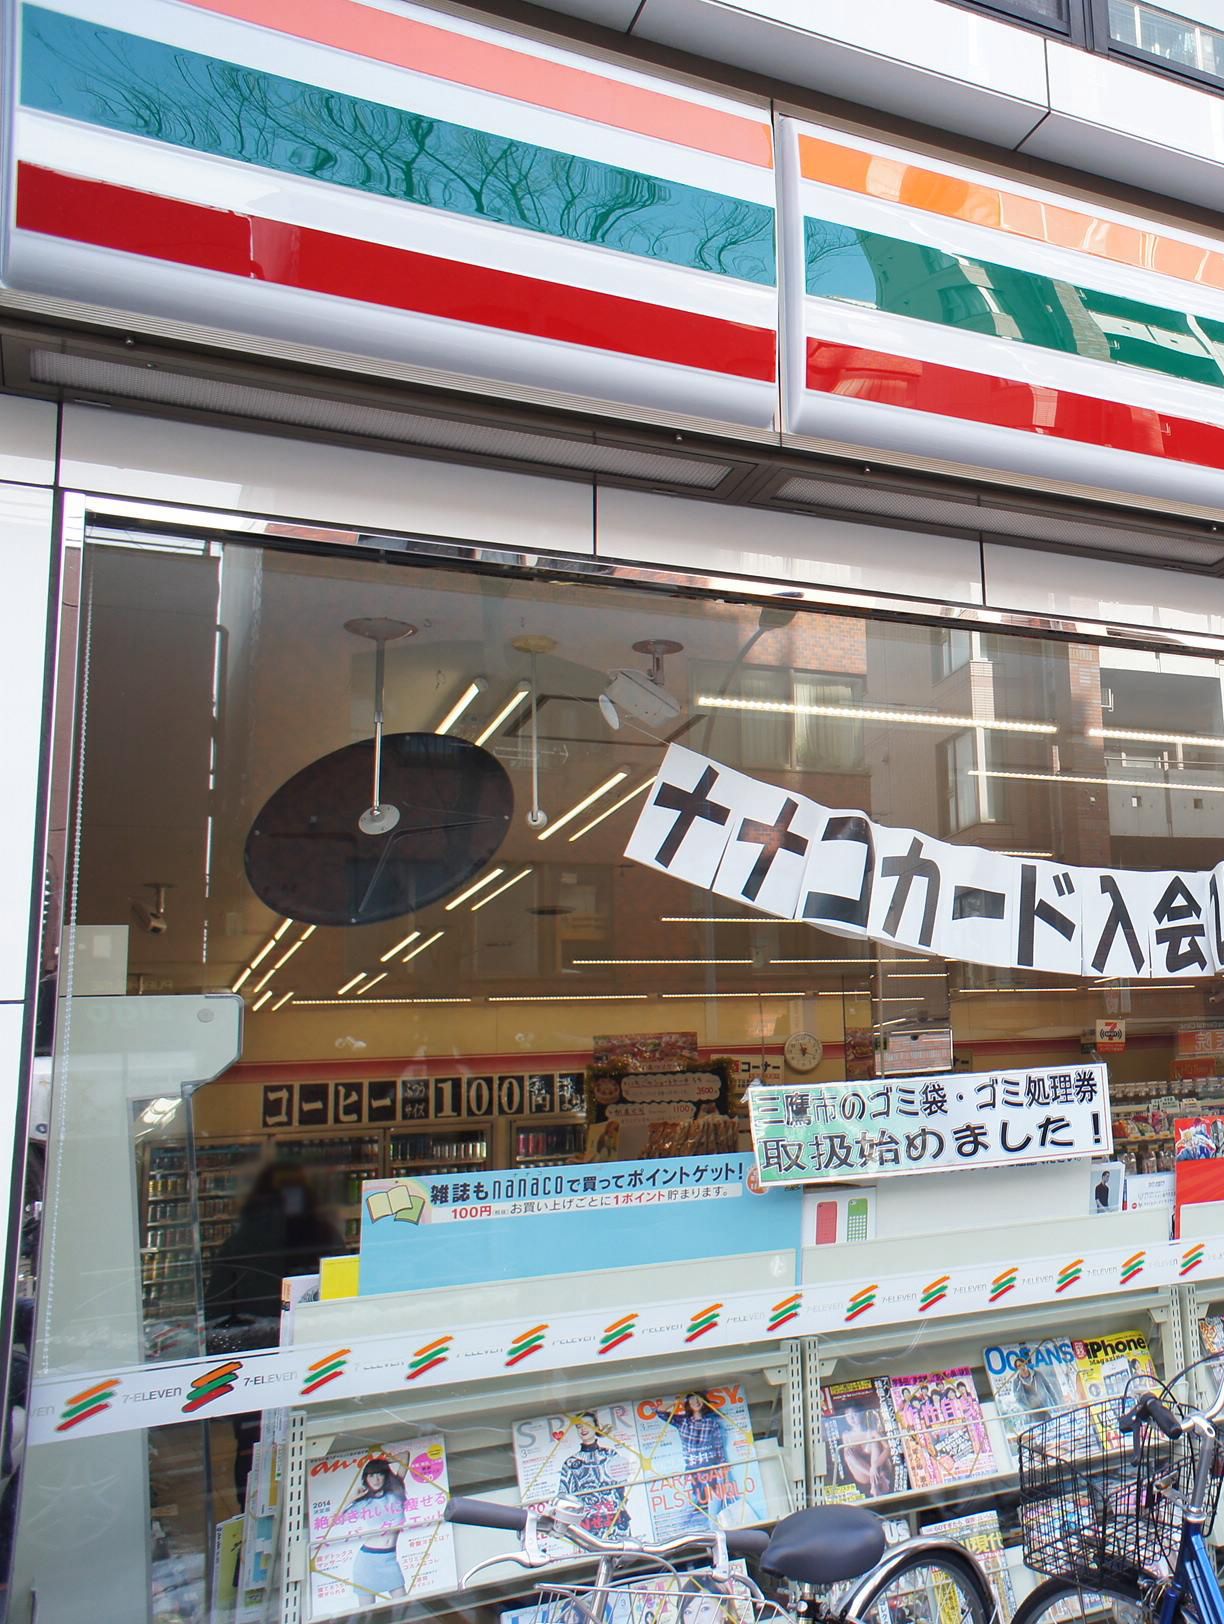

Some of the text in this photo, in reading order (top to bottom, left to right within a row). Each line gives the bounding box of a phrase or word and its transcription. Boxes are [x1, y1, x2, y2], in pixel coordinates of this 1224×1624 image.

[264, 1084, 394, 1127] コーヒー
[754, 1070, 1098, 1129] 三鷹市のゴミ袋・ゴミ処理券
[761, 1111, 1103, 1173] 取扱始めました!
[1087, 1336, 1146, 1360] iPhone
[517, 1404, 633, 1449] SPR
[313, 1500, 331, 1509] 2014
